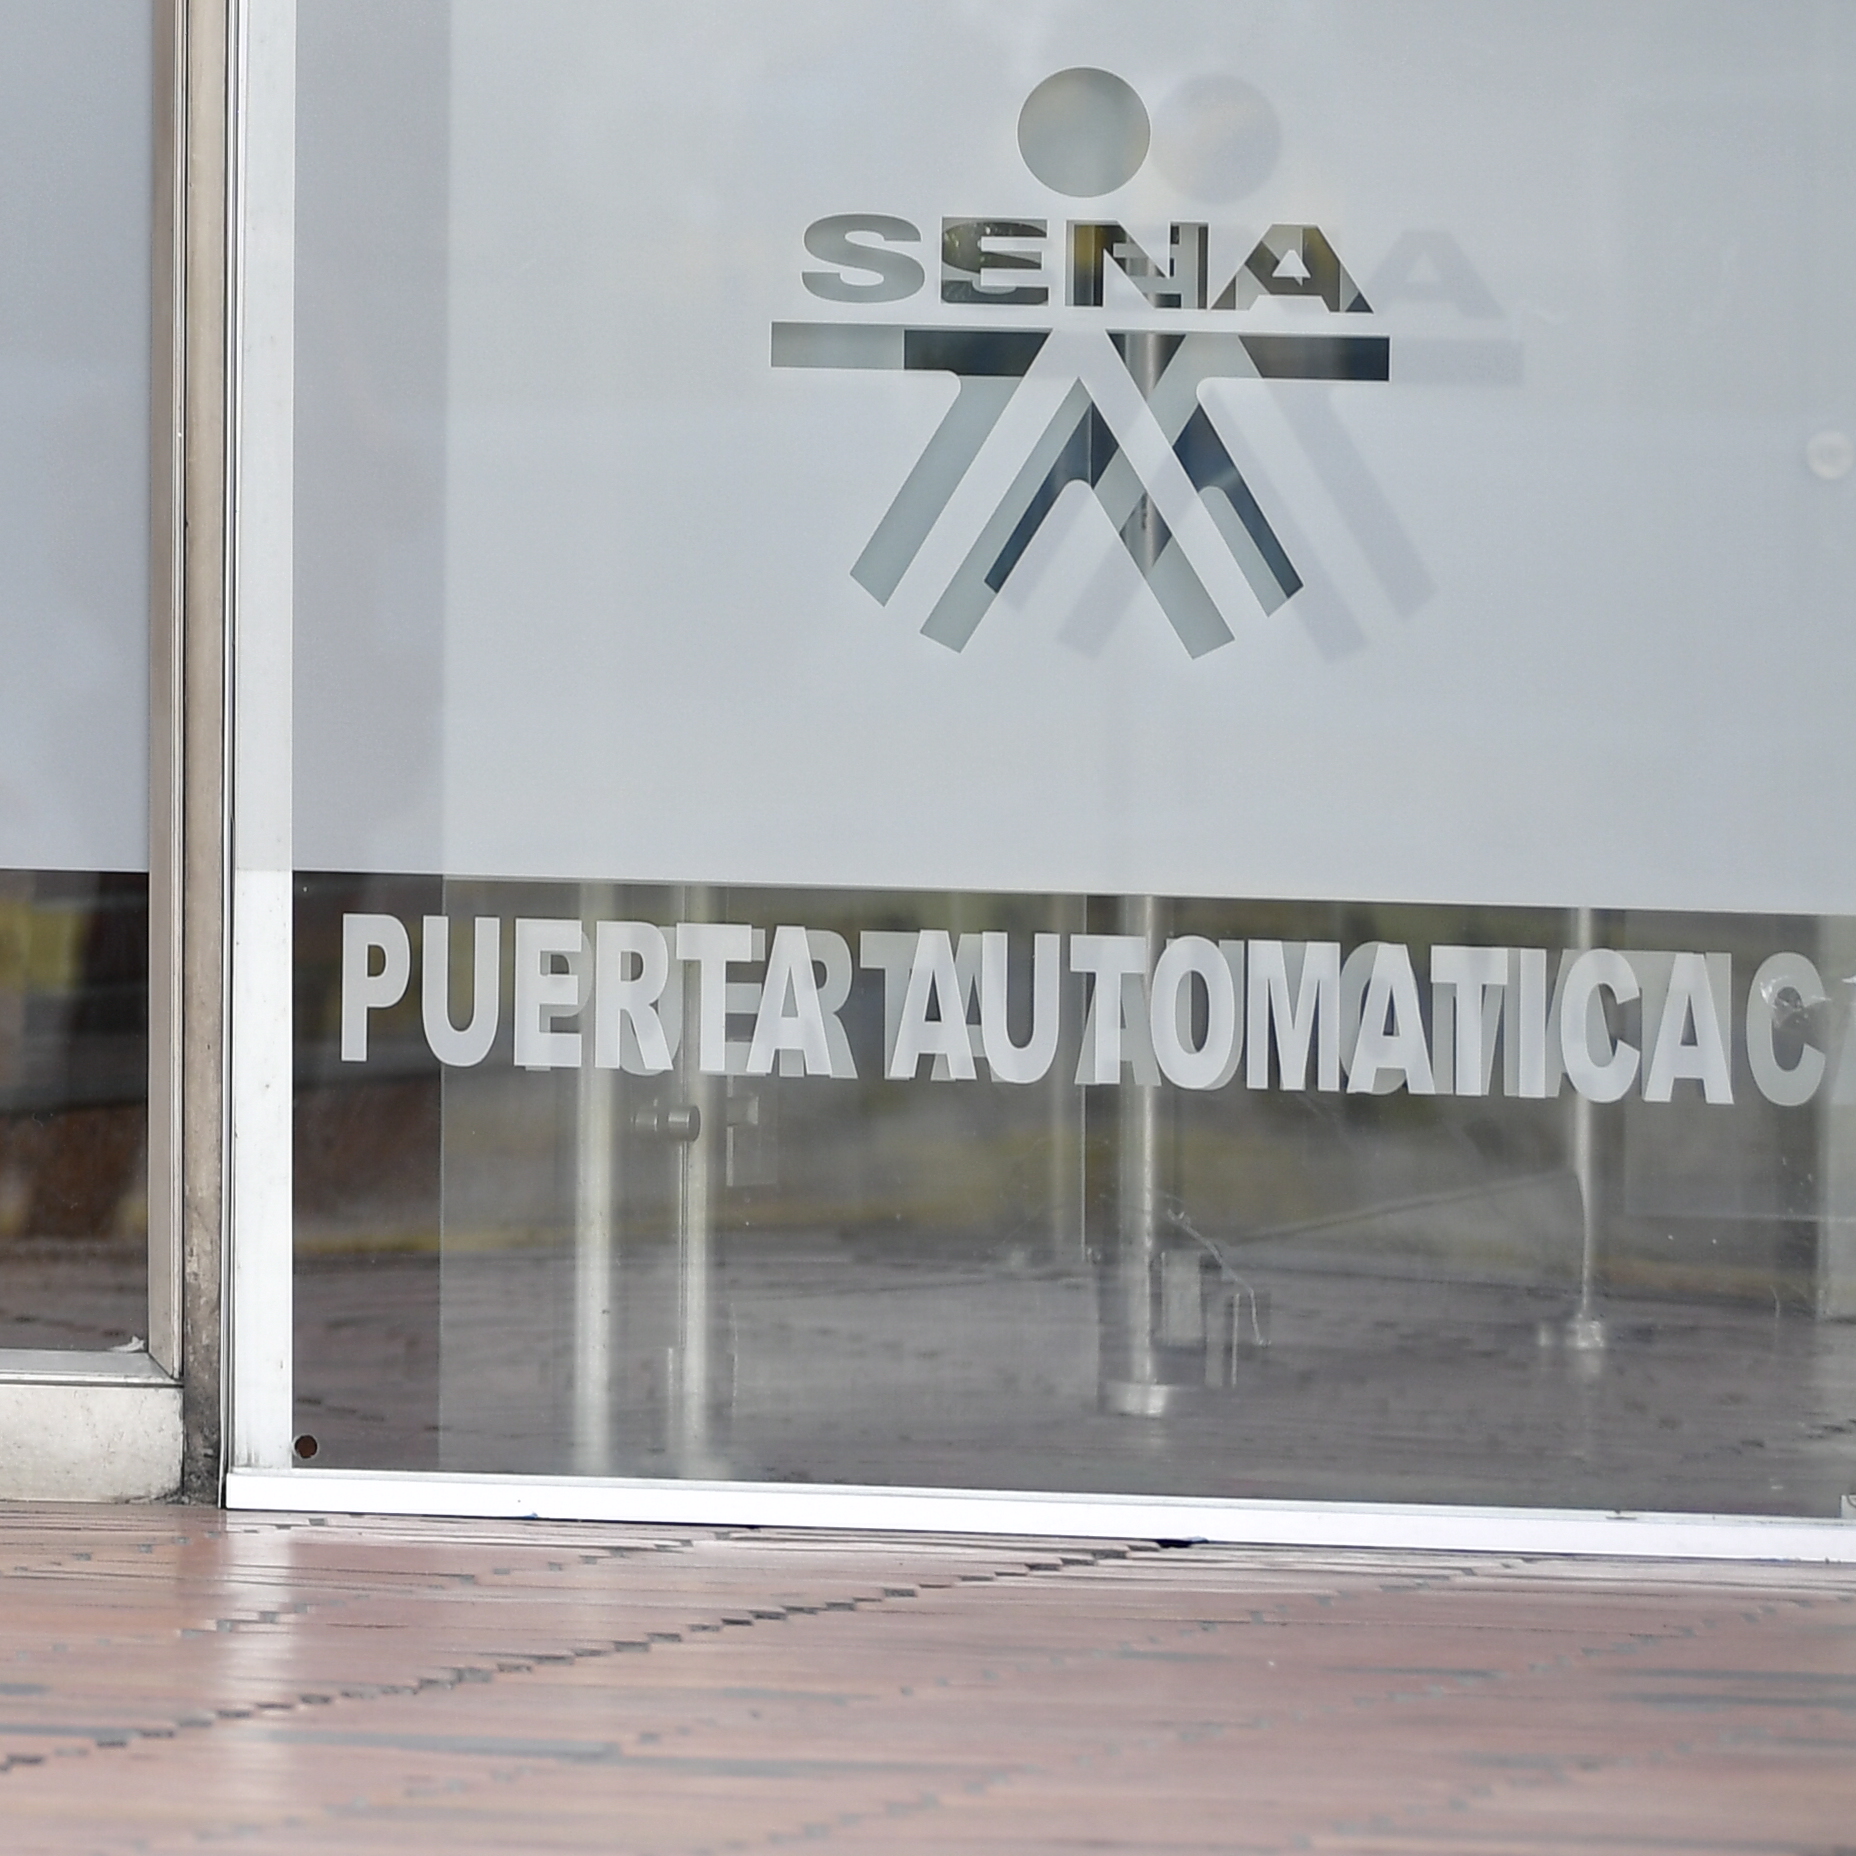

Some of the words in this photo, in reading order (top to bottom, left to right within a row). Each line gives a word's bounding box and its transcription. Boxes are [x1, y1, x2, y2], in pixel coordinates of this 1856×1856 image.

[800, 212, 1375, 314] SENA
[340, 912, 833, 1076] PUERTA
[888, 927, 1735, 1105] AUTOMATICA
